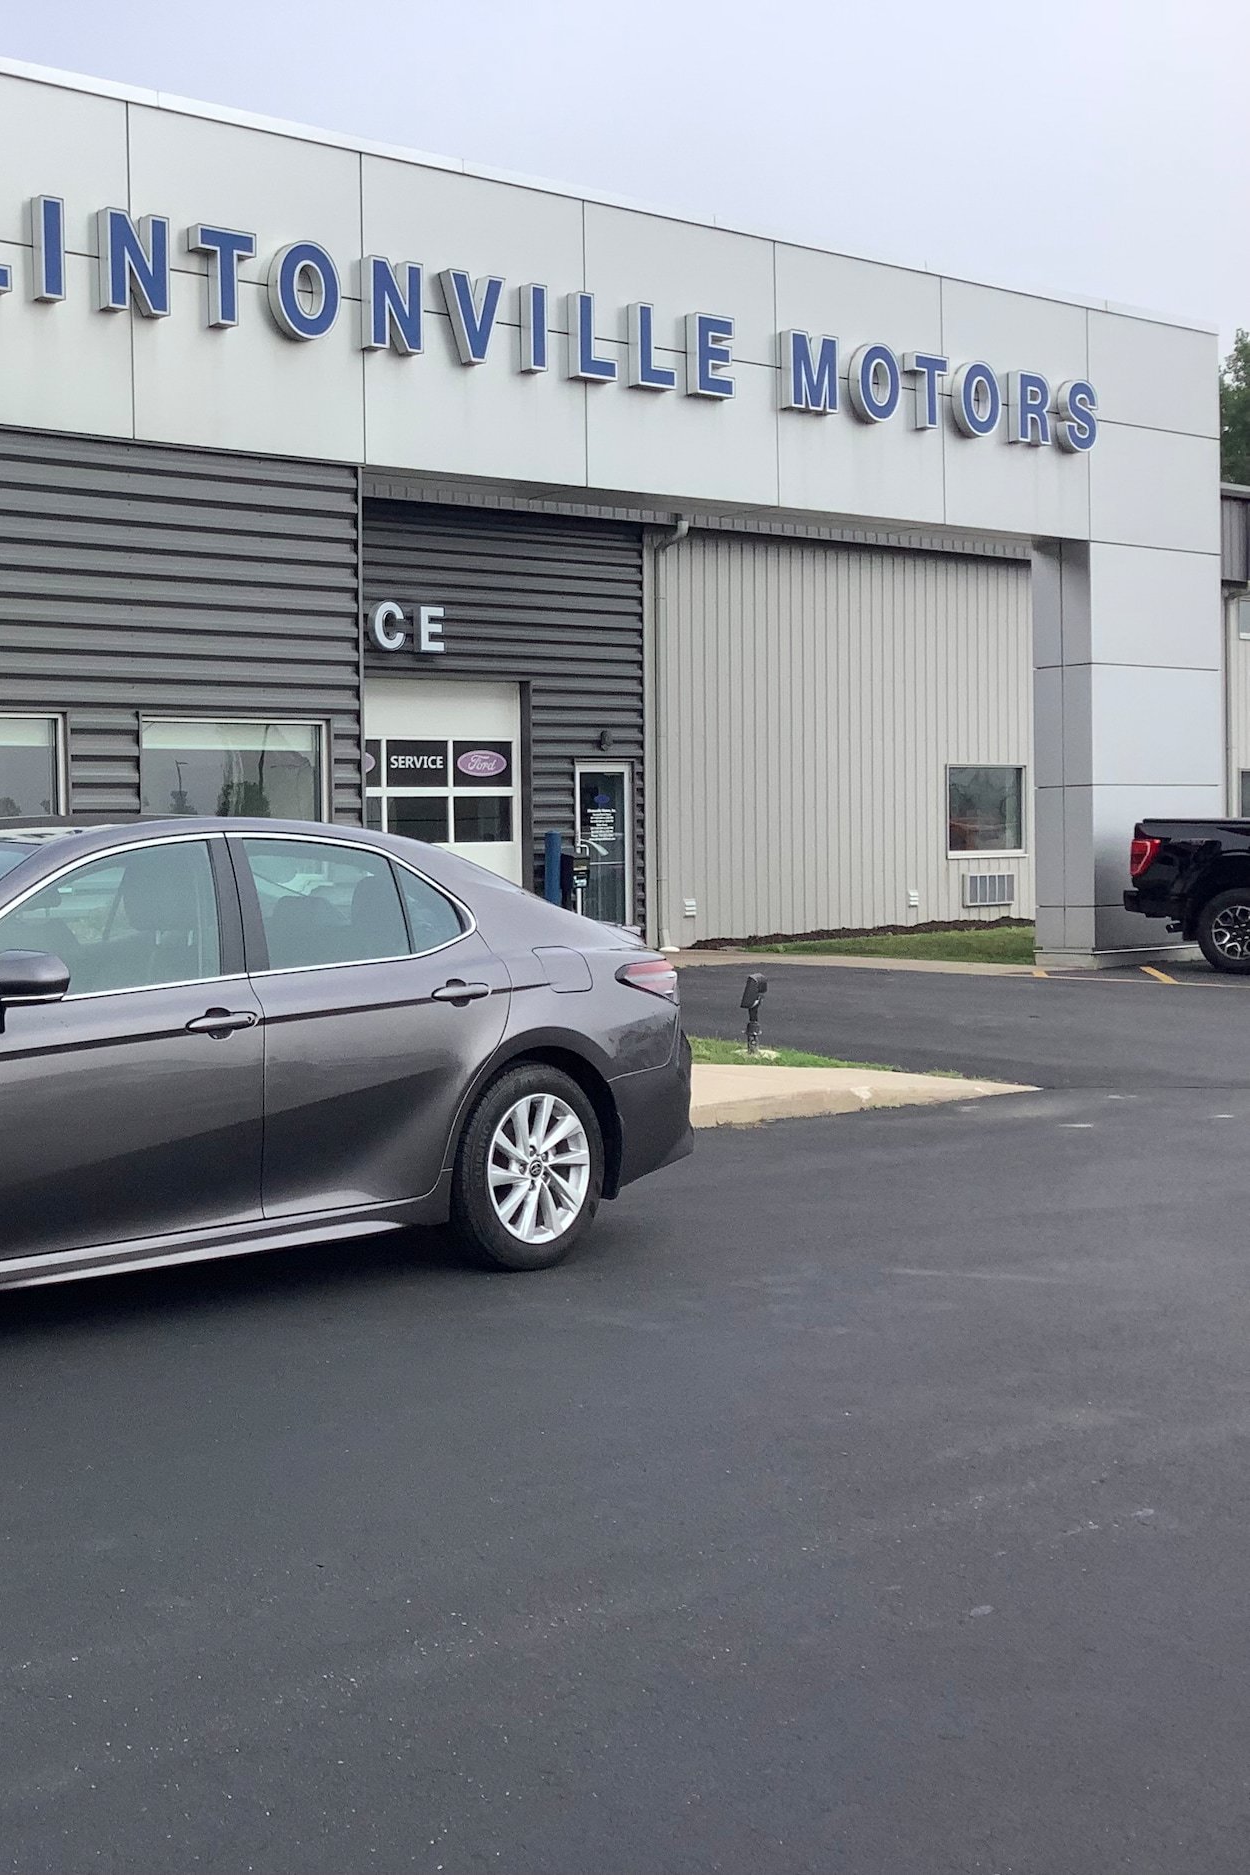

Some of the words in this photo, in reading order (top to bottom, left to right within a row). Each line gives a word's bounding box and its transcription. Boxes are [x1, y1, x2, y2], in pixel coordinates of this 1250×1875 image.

[779, 329, 1099, 453] MOTORS
[390, 755, 444, 769] SERVICE
[467, 754, 497, 771] Ford
